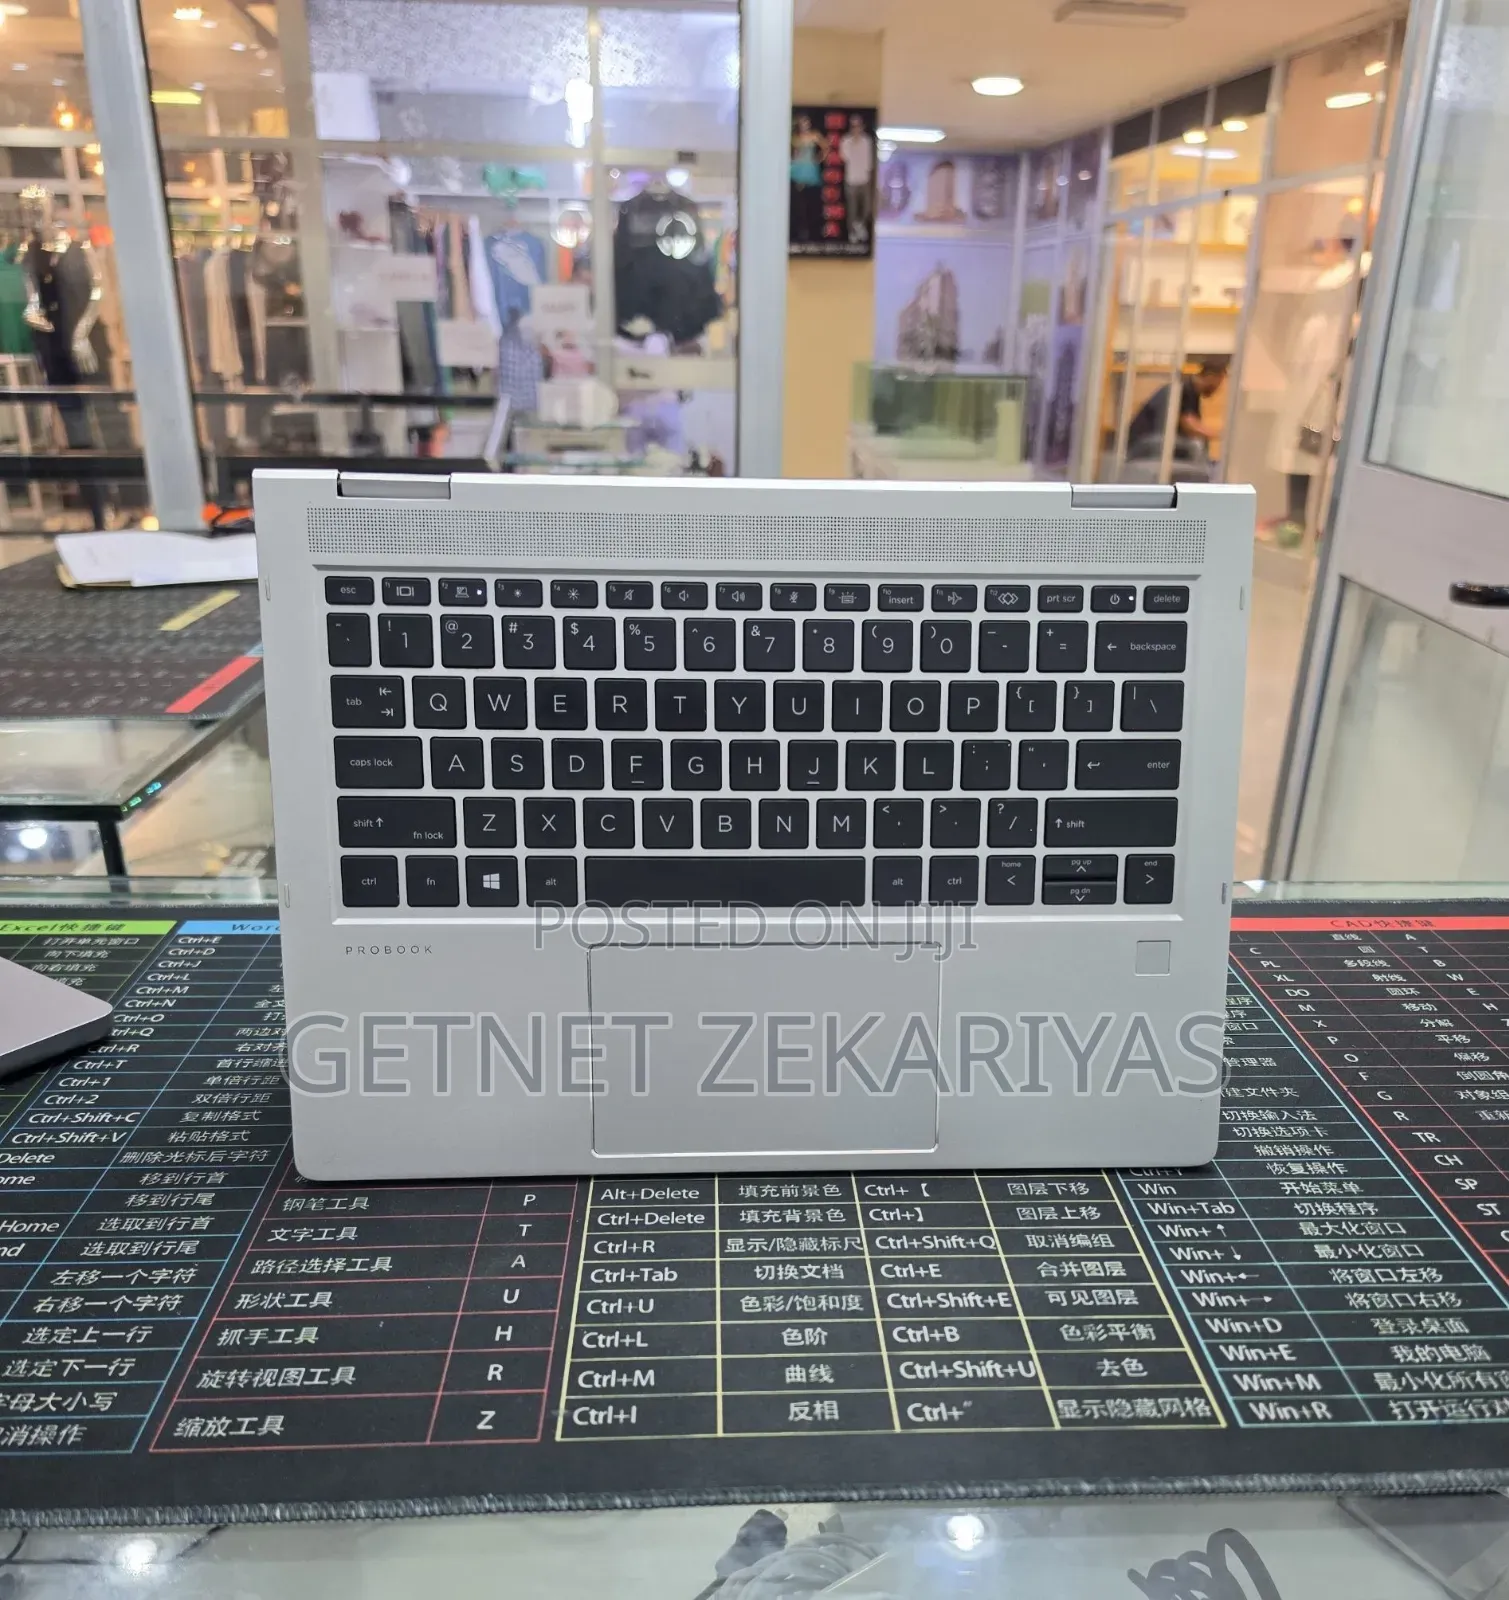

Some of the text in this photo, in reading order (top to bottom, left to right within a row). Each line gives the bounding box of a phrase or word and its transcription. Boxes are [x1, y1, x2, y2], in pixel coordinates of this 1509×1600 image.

[340, 586, 356, 594] esc
[889, 596, 913, 604] insert
[1046, 595, 1060, 603] prt
[1153, 595, 1180, 603] delete
[1130, 642, 1176, 652] backspace
[346, 698, 362, 706] tab
[430, 693, 447, 711] Q
[488, 694, 511, 711] W
[554, 695, 567, 712] E
[613, 696, 627, 713] R
[673, 696, 686, 714] T
[732, 697, 747, 714] Y
[792, 697, 806, 715] U
[907, 698, 924, 715] O
[967, 698, 980, 715] P
[350, 758, 393, 767] caps lock
[448, 754, 465, 772] A
[510, 755, 524, 773] S
[569, 755, 585, 772] D
[630, 756, 643, 773] F
[688, 757, 704, 774] G
[747, 757, 761, 774] H
[808, 757, 819, 774] J
[864, 757, 878, 774] K
[923, 757, 934, 774] L
[1147, 761, 1170, 769] enter
[353, 819, 373, 827] shift
[482, 814, 496, 831] Z
[542, 814, 556, 831] X
[600, 814, 615, 832] C
[659, 815, 675, 832] V
[718, 815, 732, 832] B
[777, 816, 791, 832] N
[833, 815, 850, 832] M
[1066, 819, 1084, 828] shift
[425, 832, 443, 840] lock
[892, 877, 903, 885] alt
[947, 877, 962, 885] ctrl
[1070, 887, 1078, 895] pg
[178, 936, 223, 945] Ctrl+E
[168, 947, 216, 956] Ctrl+D
[346, 945, 432, 955] PROBOOK
[158, 960, 202, 968] Ctrl+J
[147, 972, 191, 981] Ctrl+L
[1273, 974, 1295, 983] XL
[136, 986, 189, 995] Ctrl+M
[1285, 989, 1310, 997] DO
[124, 999, 176, 1008] Ctrl+N
[73, 1059, 128, 1069] Ctrl+T
[58, 1077, 111, 1087] Ctrl+1
[44, 1095, 100, 1105] Ctrl+2
[192, 1093, 273, 1103] 双倍行距
[28, 1111, 141, 1123] Ctrl+Shift+C
[180, 1110, 262, 1122] 复制格式
[1393, 1111, 1409, 1121] R
[12, 1131, 128, 1144] Ctrl+Shift+V
[167, 1130, 251, 1143] 粘贴格式
[1412, 1132, 1441, 1144] TR
[120, 1150, 271, 1164] 删除光标后字符
[1435, 1155, 1464, 1166] CH
[1267, 1163, 1348, 1175] 恢复操作
[139, 1171, 228, 1185] 移到行首
[1455, 1178, 1478, 1191] SP
[601, 1187, 700, 1201] Alt+Delete
[739, 1183, 842, 1198] 填充前景色
[1007, 1182, 1090, 1196] 图层下移
[1138, 1183, 1177, 1195] Win
[125, 1193, 216, 1207] 移到行尾
[283, 1196, 371, 1212] 钢笔工具
[523, 1194, 536, 1206] P
[740, 1208, 846, 1223] 填充背景色
[1016, 1206, 1101, 1221] 图层上移
[1147, 1202, 1235, 1215] Win+Tab
[1295, 1202, 1379, 1216] 切换程序
[97, 1217, 215, 1232] 选取到行首
[597, 1212, 705, 1226] Ctrl+Delete
[268, 1226, 358, 1242] 文字工具
[520, 1224, 532, 1237] T
[1158, 1224, 1212, 1238] Win+
[1299, 1222, 1407, 1237] 最大化窗口
[80, 1241, 200, 1256] 选取到行尾
[593, 1240, 655, 1254] Ctrl+R
[724, 1237, 862, 1253] 显示/隐藏标尺
[875, 1236, 997, 1251] Ctrl+Shift+Q
[1026, 1233, 1115, 1249] 取消编组
[1170, 1247, 1225, 1261] Win+
[1314, 1244, 1425, 1260] 最小化窗口
[251, 1257, 393, 1274] 路径选择工具
[511, 1255, 526, 1268] A
[1036, 1261, 1127, 1278] 合并图层
[51, 1268, 198, 1285] 左移一个字符
[590, 1267, 678, 1283] Ctrl+Tab
[754, 1264, 845, 1280] 切换文档
[880, 1264, 942, 1278] Ctrl+E
[1330, 1268, 1444, 1284] 将窗口左移
[33, 1295, 184, 1314] 右移一个字符
[235, 1292, 334, 1310] 形状工具
[504, 1289, 520, 1304] U
[740, 1295, 864, 1312] 色彩/饱和度
[887, 1292, 1011, 1309] Ctrl+Shift+E
[1045, 1289, 1139, 1307] 可见图层
[586, 1298, 655, 1315] Ctrl+U
[495, 1326, 513, 1341] H
[893, 1326, 960, 1343] Ctrl+B
[1059, 1324, 1157, 1342] 色彩平衡
[1205, 1319, 1283, 1334] Win+D
[22, 1326, 154, 1344] 选定上一行
[217, 1327, 319, 1347] 抓手工具
[582, 1332, 649, 1349] Ctrl+L
[781, 1328, 828, 1347] 色阶
[1219, 1345, 1296, 1362] Win+E
[1390, 1344, 1492, 1363] 我的电脑
[2, 1358, 136, 1377] 选定下一行
[487, 1365, 504, 1381] R
[785, 1364, 834, 1384] 曲线
[899, 1360, 1036, 1380] Ctrl+Shift+U
[1096, 1358, 1147, 1378] 去色
[196, 1366, 357, 1388] 旋转视图工具
[578, 1369, 655, 1388] Ctrl+M
[1234, 1373, 1322, 1392] Win+M
[788, 1401, 839, 1421] 反相
[1057, 1398, 1213, 1420] 显示隐藏网格
[1250, 1402, 1333, 1421] Win+R
[174, 1415, 285, 1438] 缩放工具
[477, 1411, 495, 1430] Z
